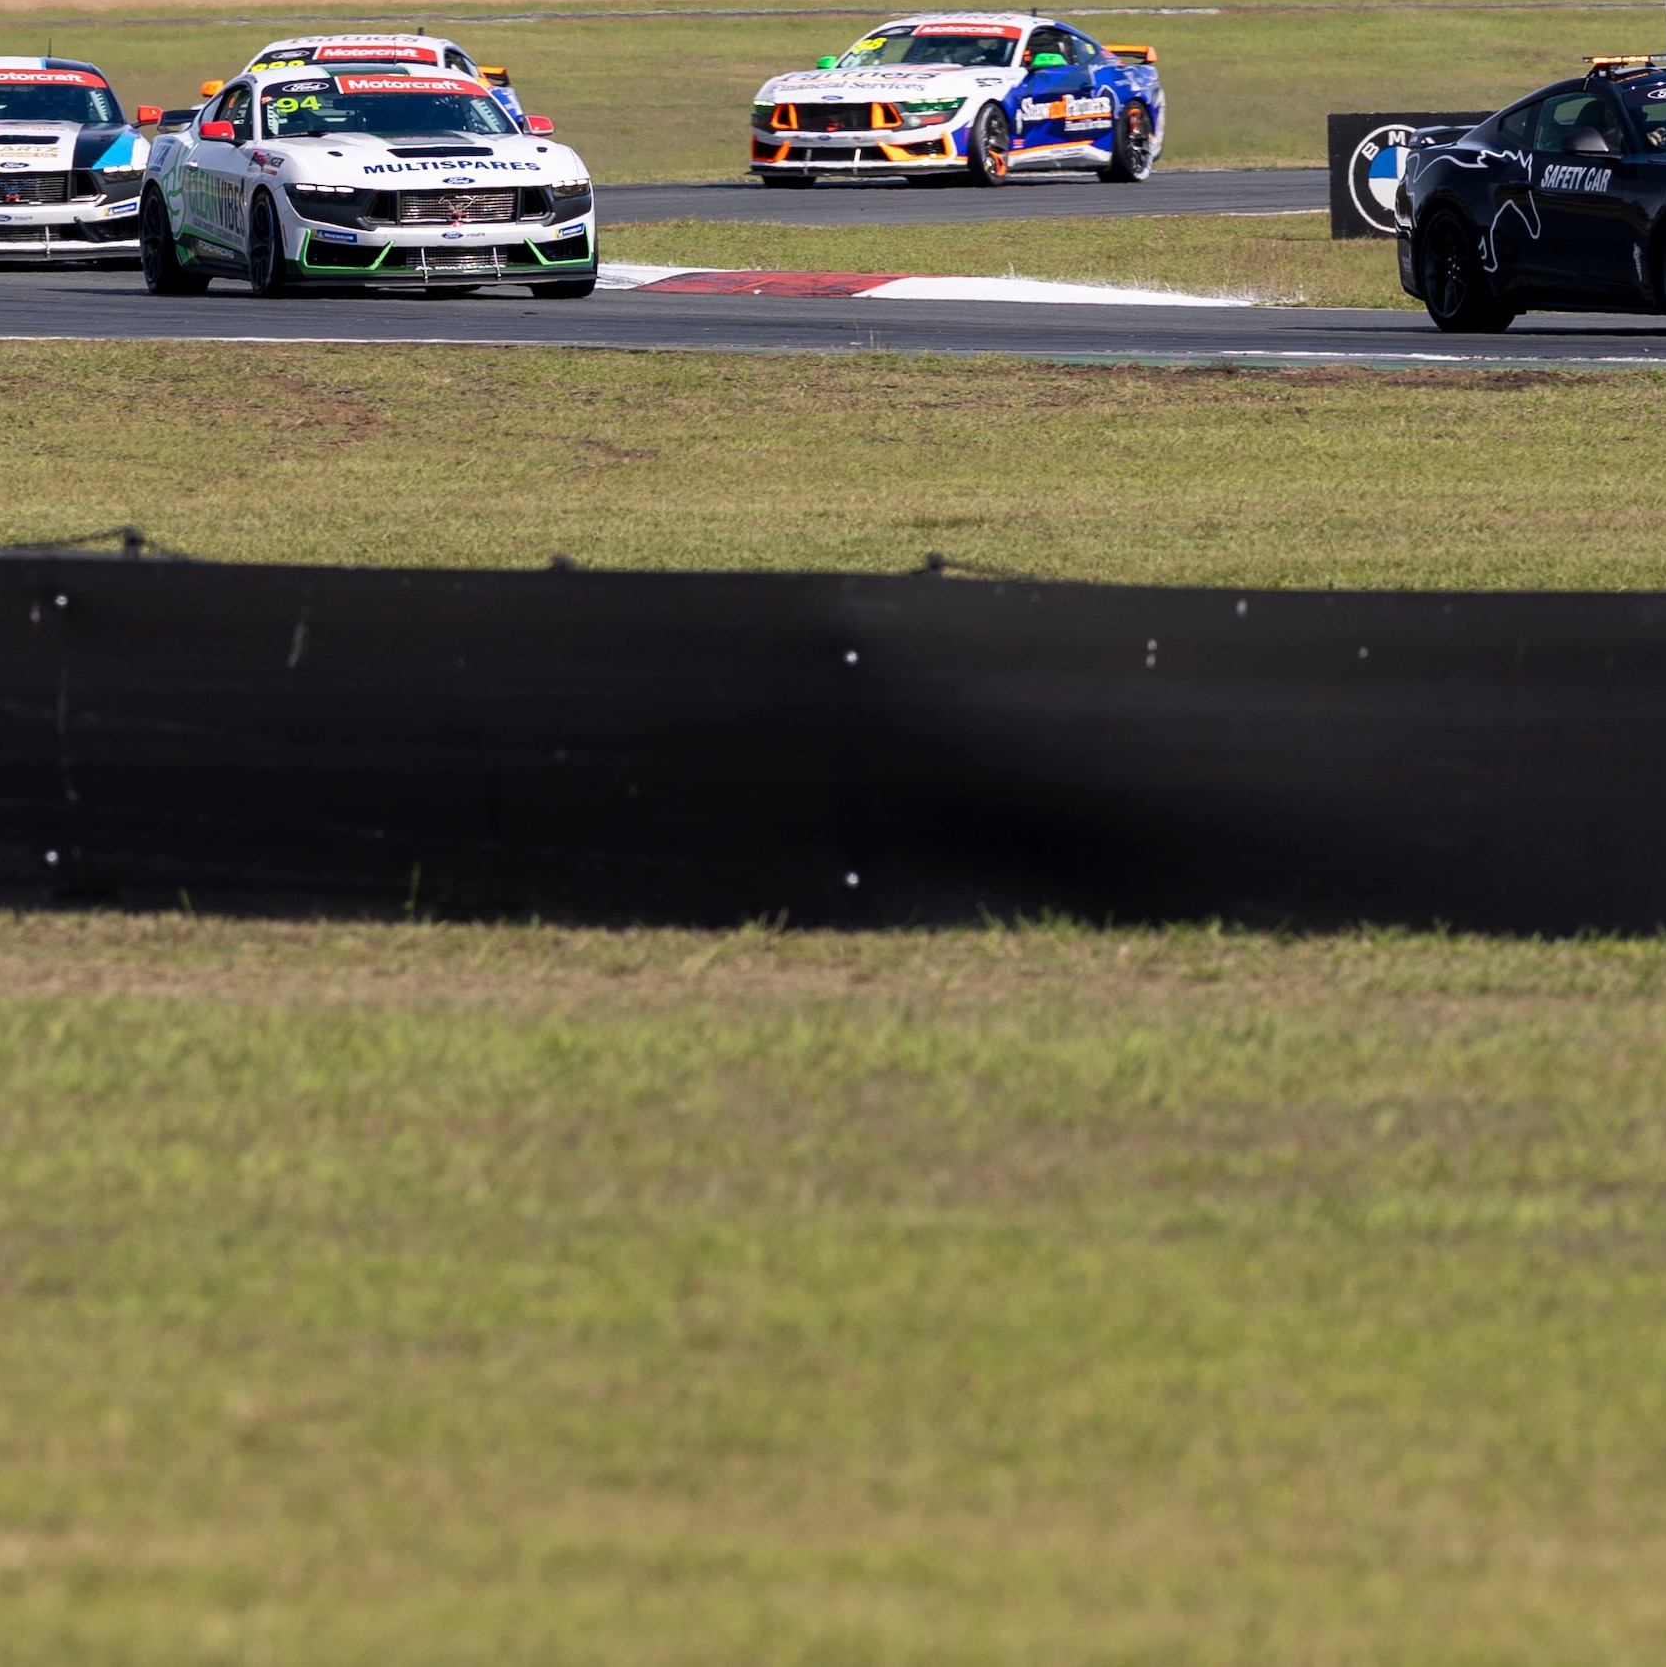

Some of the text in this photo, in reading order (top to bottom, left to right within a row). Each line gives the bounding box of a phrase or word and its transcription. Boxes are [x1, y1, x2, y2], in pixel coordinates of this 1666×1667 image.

[322, 48, 420, 59] Motorcraft
[347, 78, 466, 91] Motorcraft
[276, 95, 322, 113] 94
[363, 160, 542, 175] MULTISPARES
[1541, 164, 1613, 193] SAFETY CAR
